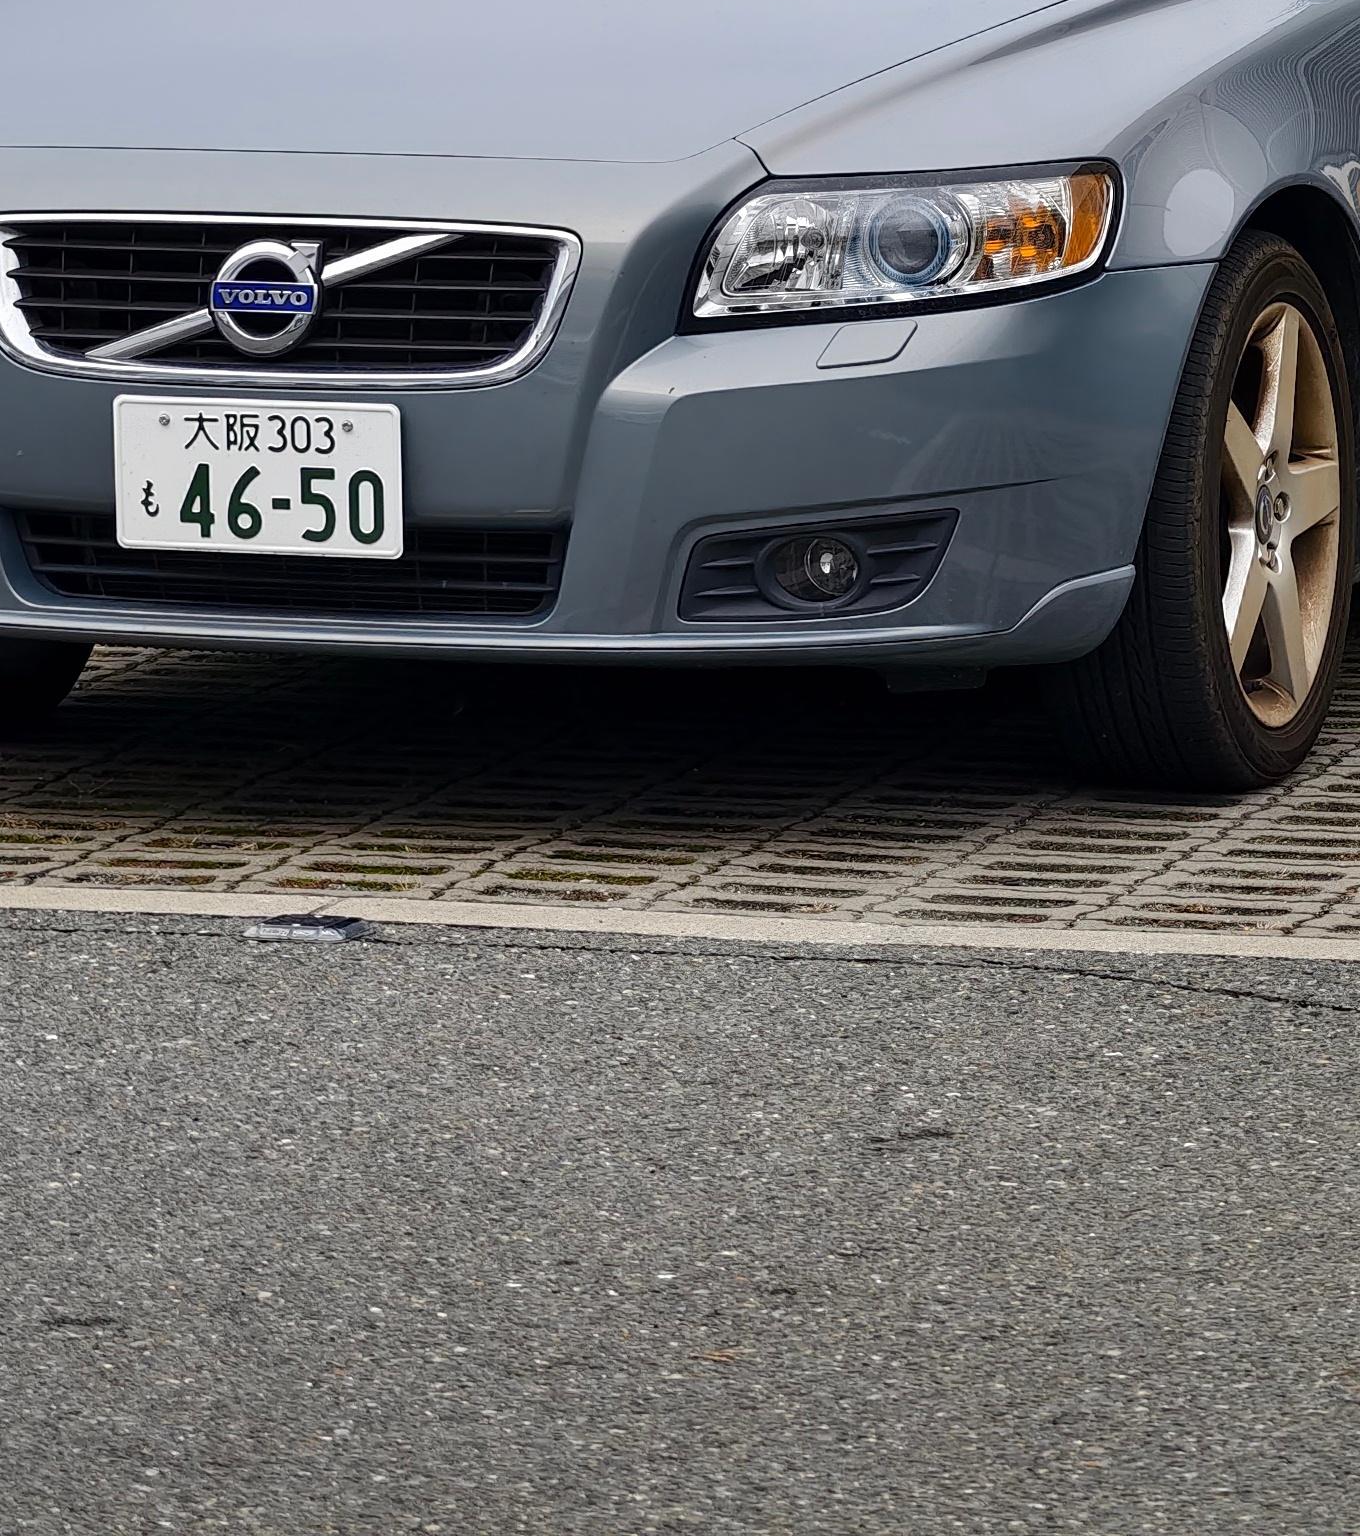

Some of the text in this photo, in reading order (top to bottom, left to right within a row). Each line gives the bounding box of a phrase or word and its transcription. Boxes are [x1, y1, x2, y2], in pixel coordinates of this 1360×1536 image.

[218, 288, 308, 306] VOLVO
[183, 412, 337, 455] 大阪303
[141, 462, 386, 545] も 46-50
